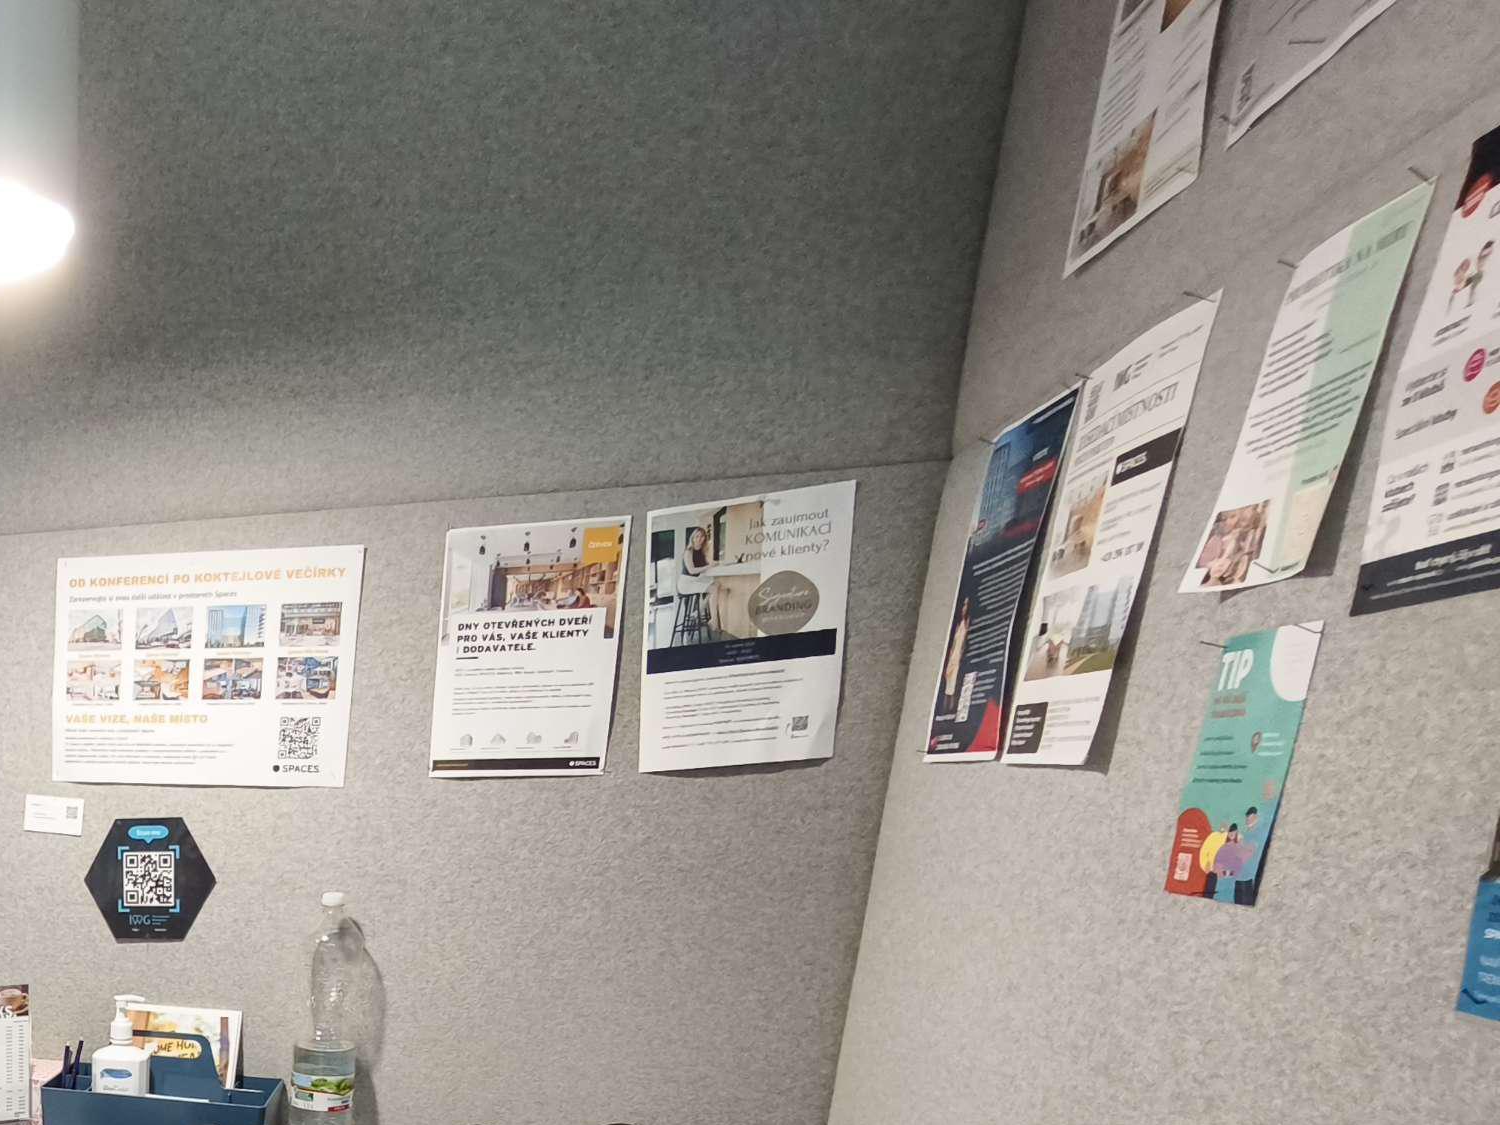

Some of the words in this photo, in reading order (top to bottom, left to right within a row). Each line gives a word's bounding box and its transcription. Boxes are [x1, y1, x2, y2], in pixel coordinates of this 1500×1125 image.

[771, 509, 829, 527] zaujmout
[780, 540, 830, 557] klienty?
[69, 578, 86, 588] OD
[173, 574, 191, 584] PO
[194, 567, 281, 583] KOKTEJLOVÉ
[286, 565, 347, 580] VEČÍRKY
[458, 622, 479, 631] DNY
[483, 618, 555, 630] OTEVŘENÝCH
[559, 613, 592, 626] DVEŘÍ
[457, 634, 477, 643] PRO
[482, 631, 505, 642] VÁS,
[511, 629, 538, 640] VAŠE
[542, 629, 589, 638] KLIENTY
[1218, 649, 1254, 691] TIP
[66, 712, 96, 724] VAŠE
[134, 711, 165, 724] NAŠE
[169, 711, 208, 724] MÍSTO
[282, 764, 320, 774] SPACES
